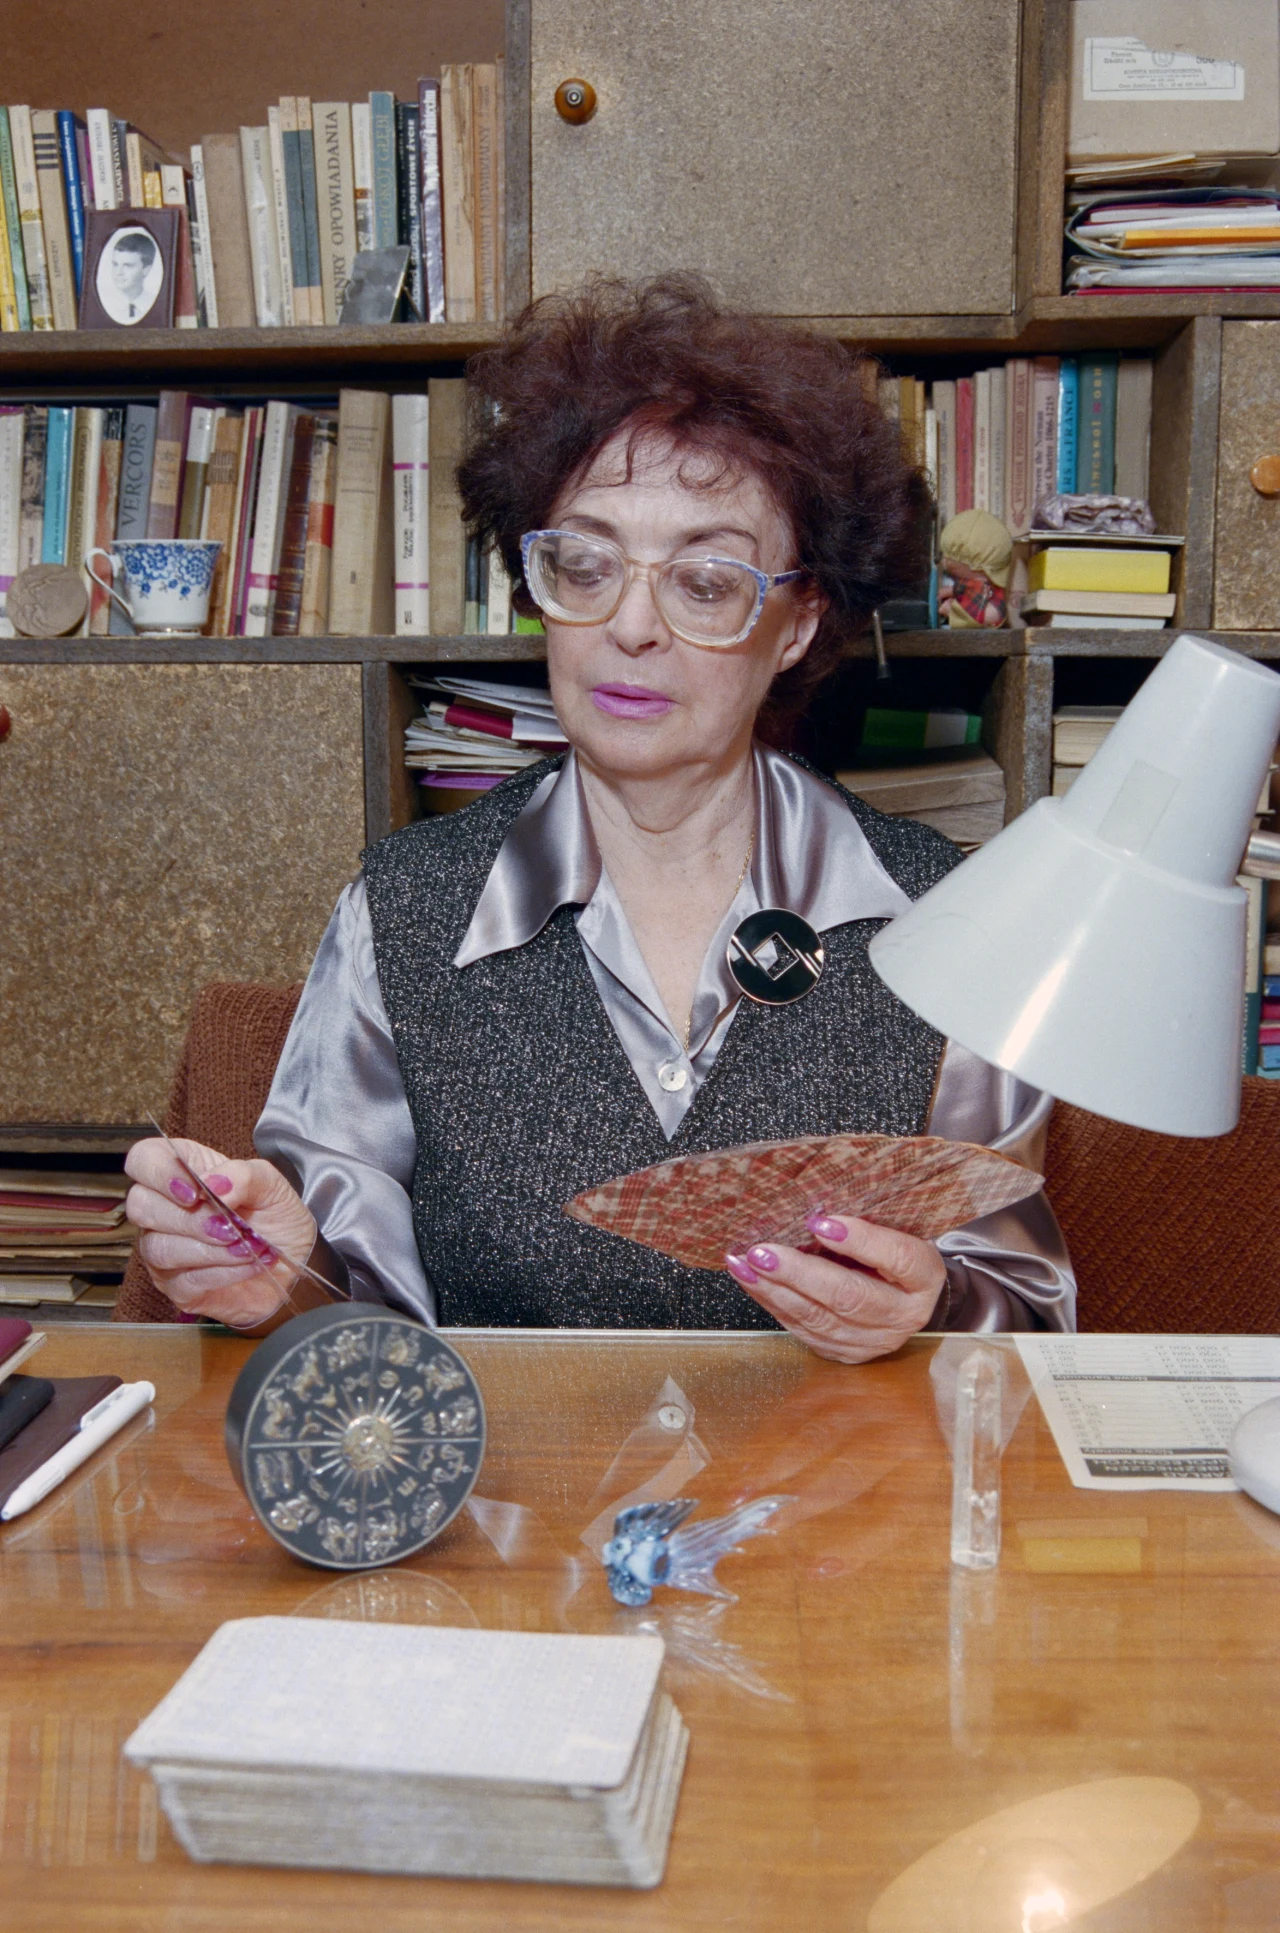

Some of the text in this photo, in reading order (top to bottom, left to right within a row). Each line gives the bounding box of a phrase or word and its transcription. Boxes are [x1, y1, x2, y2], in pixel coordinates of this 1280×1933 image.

[406, 119, 416, 152] ŻYCIE
[324, 110, 345, 246] OPOWIADANIA
[408, 154, 418, 217] SPORTOWE
[1034, 410, 1044, 447] Norman
[1043, 395, 1055, 442] 1066-1215
[121, 422, 147, 528] VERCORS
[1034, 450, 1043, 465] the
[1044, 445, 1054, 479] Charter
[1062, 467, 1073, 494] ERS
